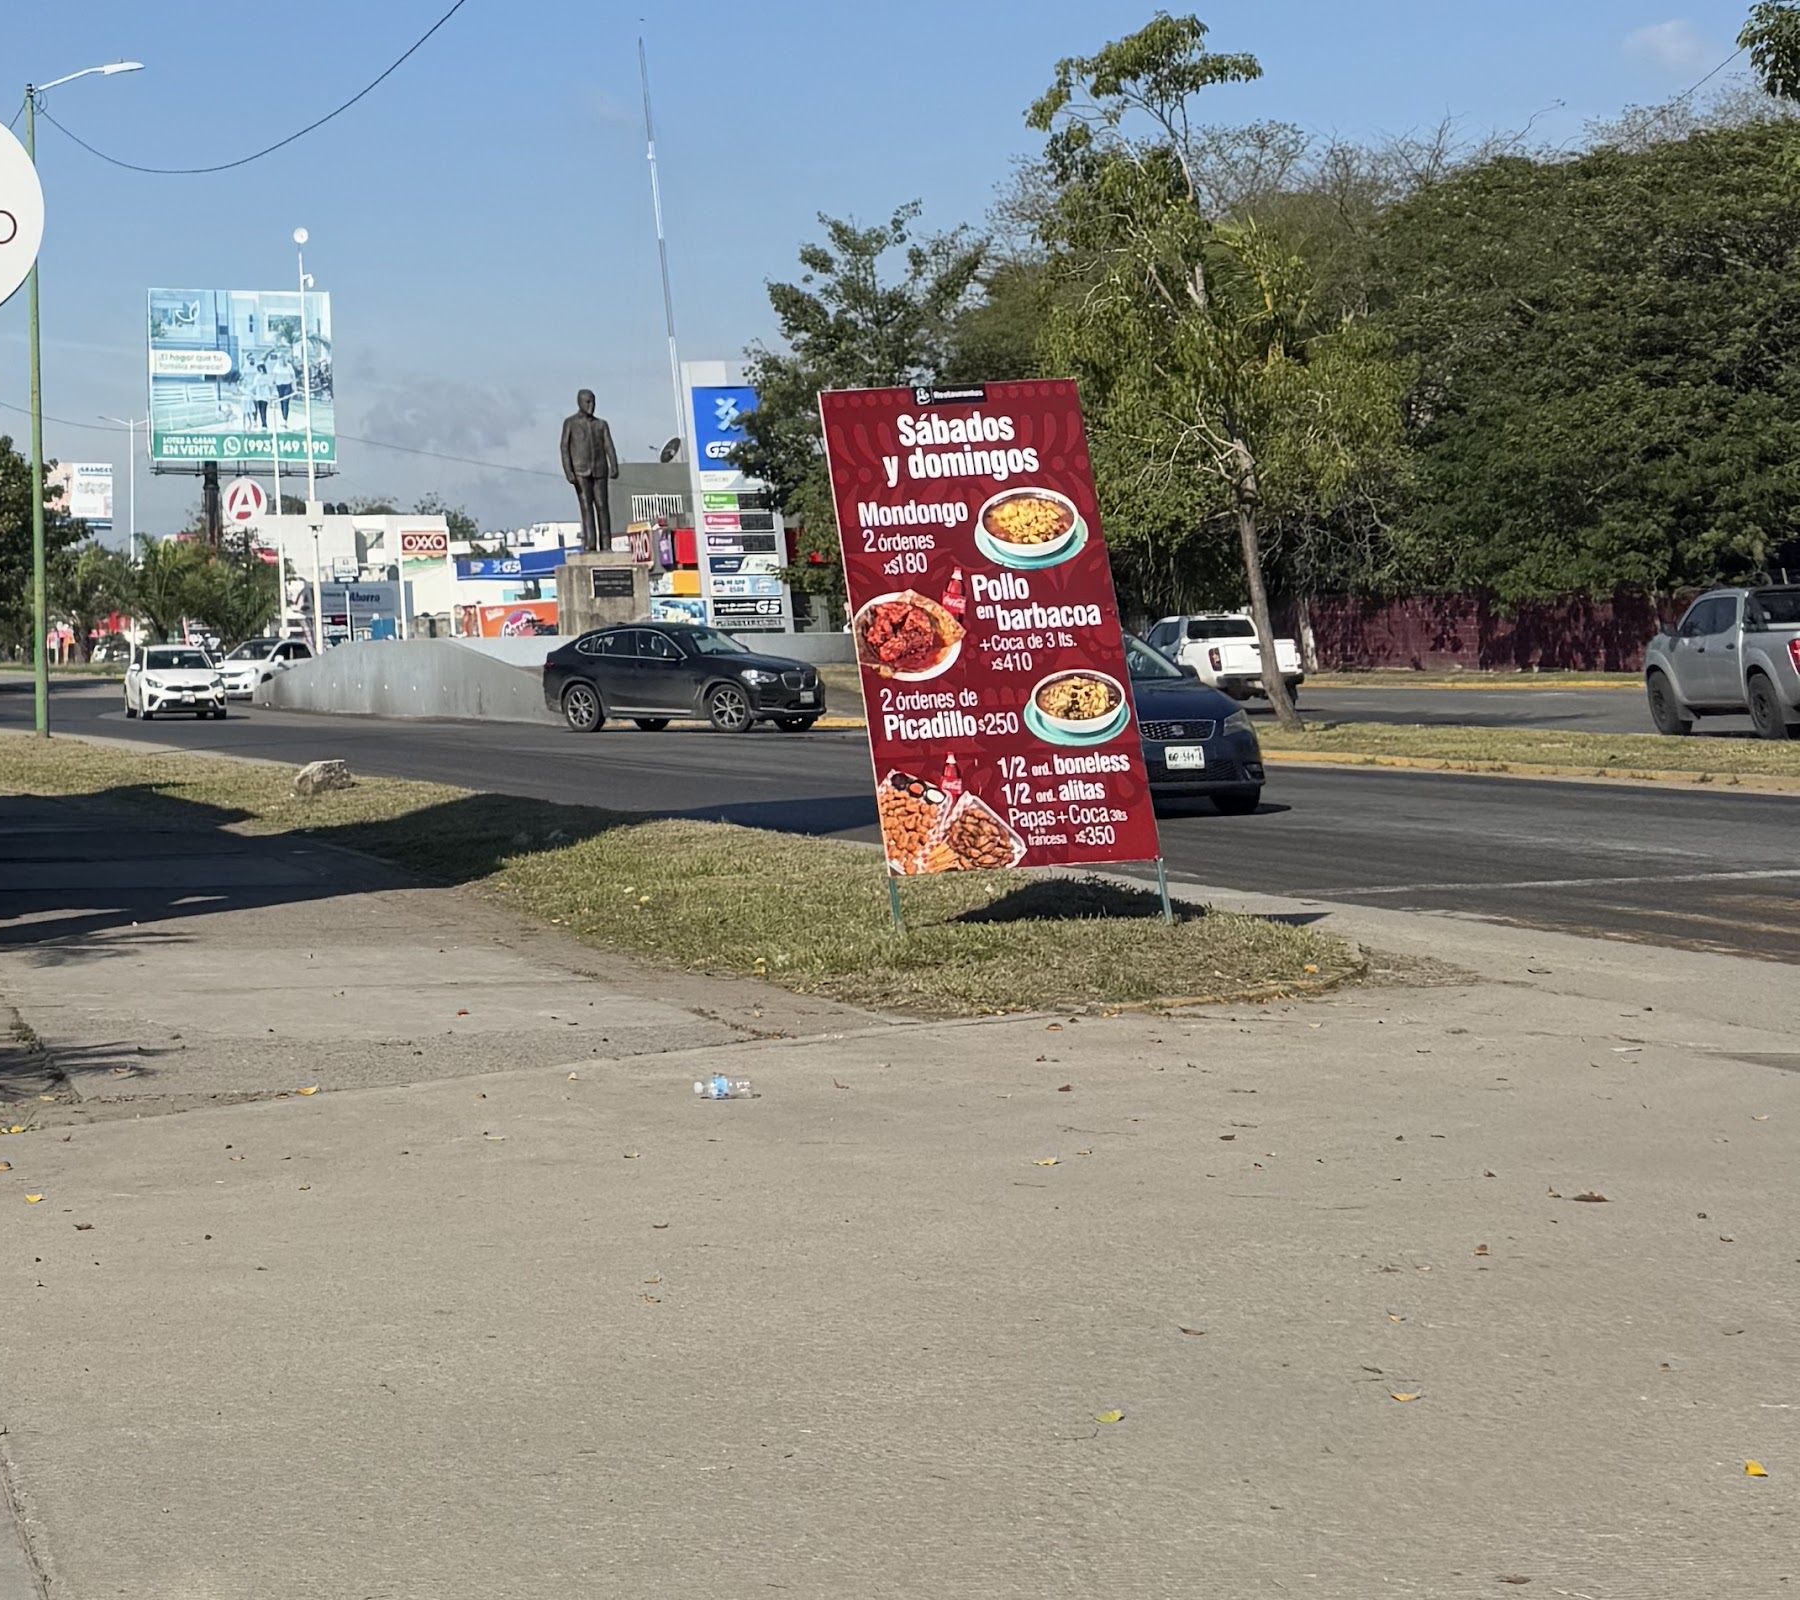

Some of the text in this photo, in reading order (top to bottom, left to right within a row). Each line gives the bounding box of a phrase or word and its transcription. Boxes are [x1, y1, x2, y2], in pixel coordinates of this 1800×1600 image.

[896, 410, 1016, 447] Sábados
[162, 445, 218, 456] EN VENTA
[882, 444, 1040, 488] y domingos
[857, 499, 969, 528] Mondongo
[404, 535, 446, 550] OXXO
[862, 529, 936, 552] 2 órdenes
[970, 572, 1030, 602] Pollo
[976, 604, 995, 620] en
[995, 602, 1102, 631] barbacoa
[1027, 632, 1043, 649] de
[1045, 632, 1056, 648] 3
[880, 687, 978, 712] 2 órdenes de
[883, 710, 1019, 741] Picadillo $250
[997, 751, 1131, 780] 1/2 ord. boneless
[1001, 779, 1106, 806] 1/2 ord. alitas
